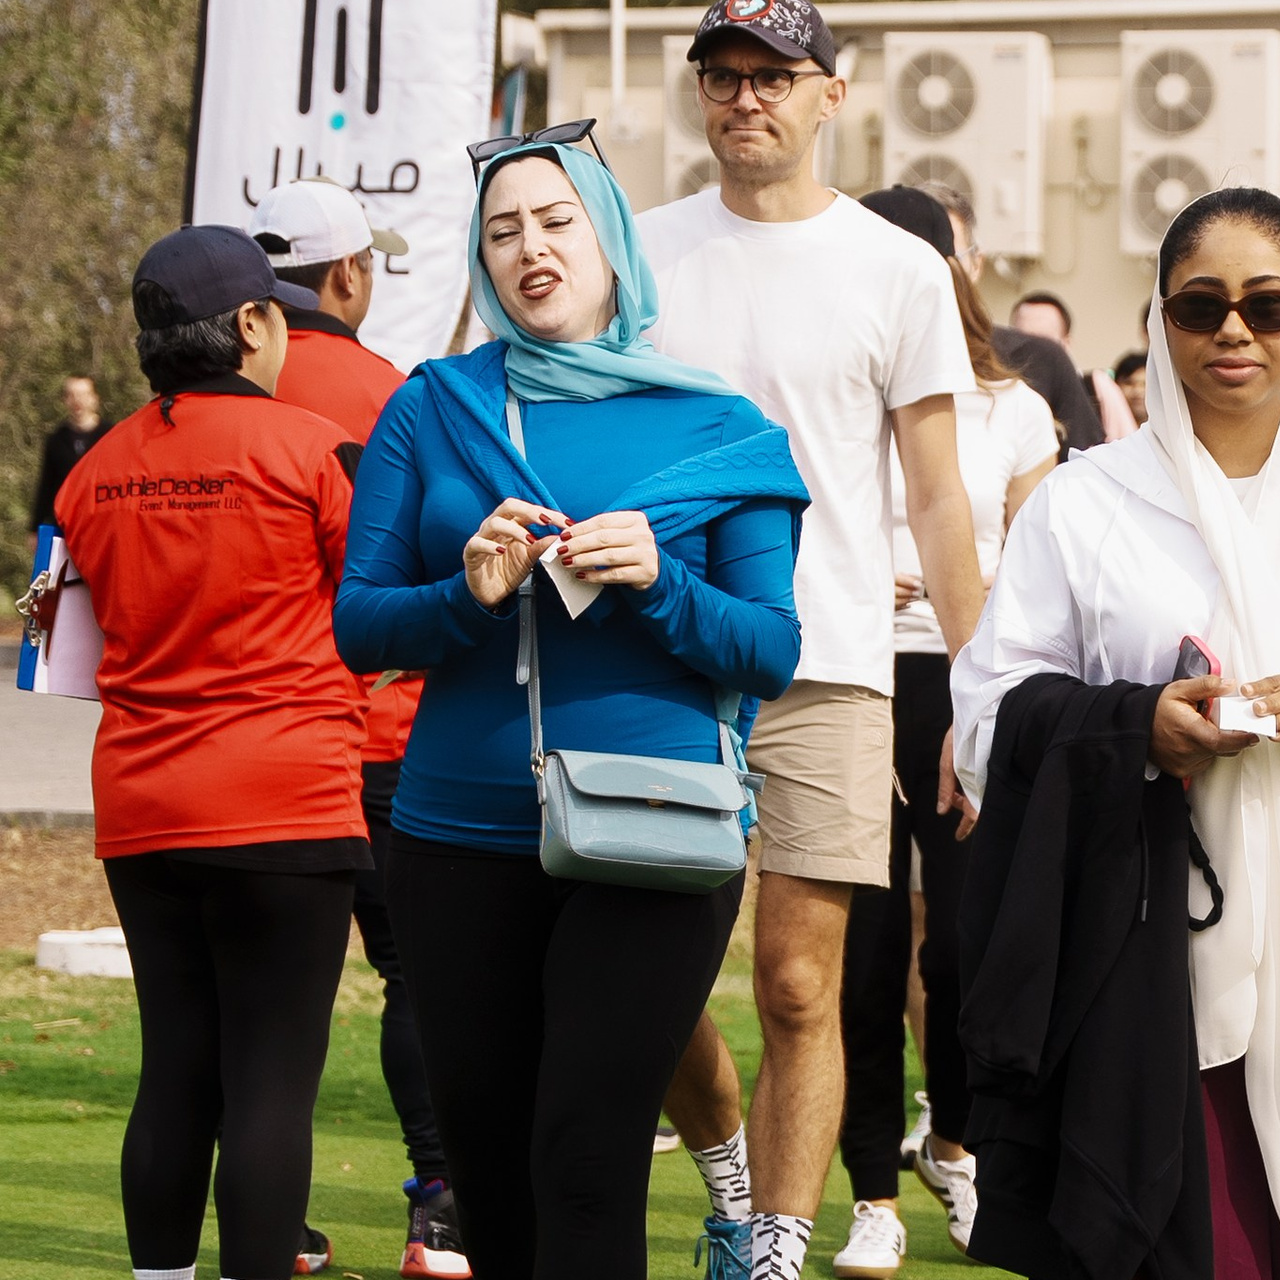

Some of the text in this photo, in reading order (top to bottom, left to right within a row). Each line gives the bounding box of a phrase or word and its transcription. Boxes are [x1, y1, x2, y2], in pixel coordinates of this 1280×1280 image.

[139, 497, 242, 512] Event Management LLC
